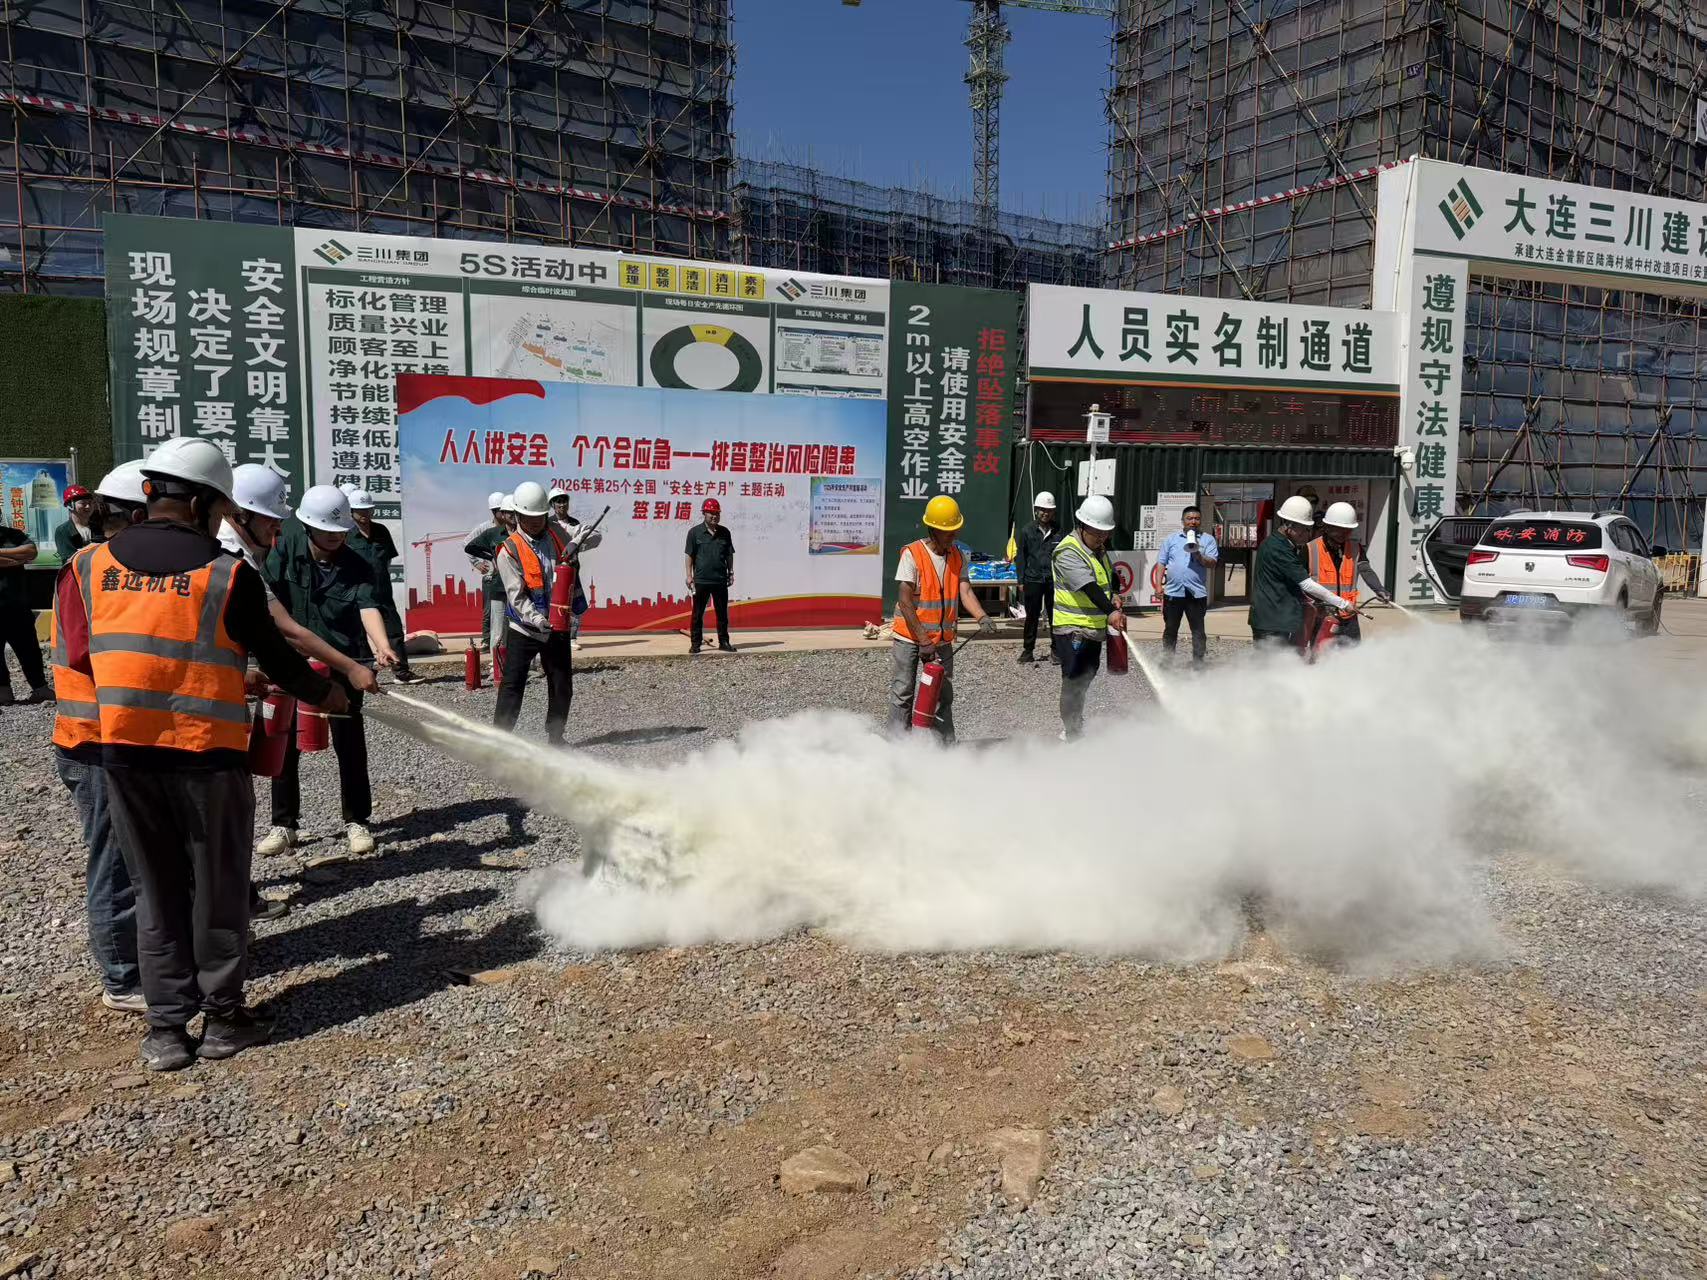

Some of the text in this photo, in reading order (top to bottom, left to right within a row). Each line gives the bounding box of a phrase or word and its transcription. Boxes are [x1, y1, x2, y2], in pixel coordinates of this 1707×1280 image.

[357, 246, 429, 262] 三川集团
[459, 252, 608, 284] 5S活动中
[625, 263, 640, 286] 整理
[655, 267, 670, 289] 整顿
[715, 272, 728, 293] 清扫
[810, 284, 867, 300] 三川集团
[325, 288, 449, 315] 标化管理
[327, 312, 449, 337] 质量兴业
[328, 335, 449, 359] 顾客至上
[1067, 303, 1374, 374] 人员实名制通道
[128, 251, 182, 459] 现场规章制
[241, 257, 291, 494] 安全文明靠大
[329, 382, 397, 403] 节能
[900, 304, 934, 500] 2m以上高空作业
[973, 328, 1008, 477] 拒绝坠落事故
[330, 405, 398, 425] 持续
[936, 346, 971, 495] 请使用安全带
[332, 428, 399, 448] 降低
[332, 451, 400, 471] 遵规
[333, 474, 401, 494] 健康
[632, 500, 692, 522] 签到墙
